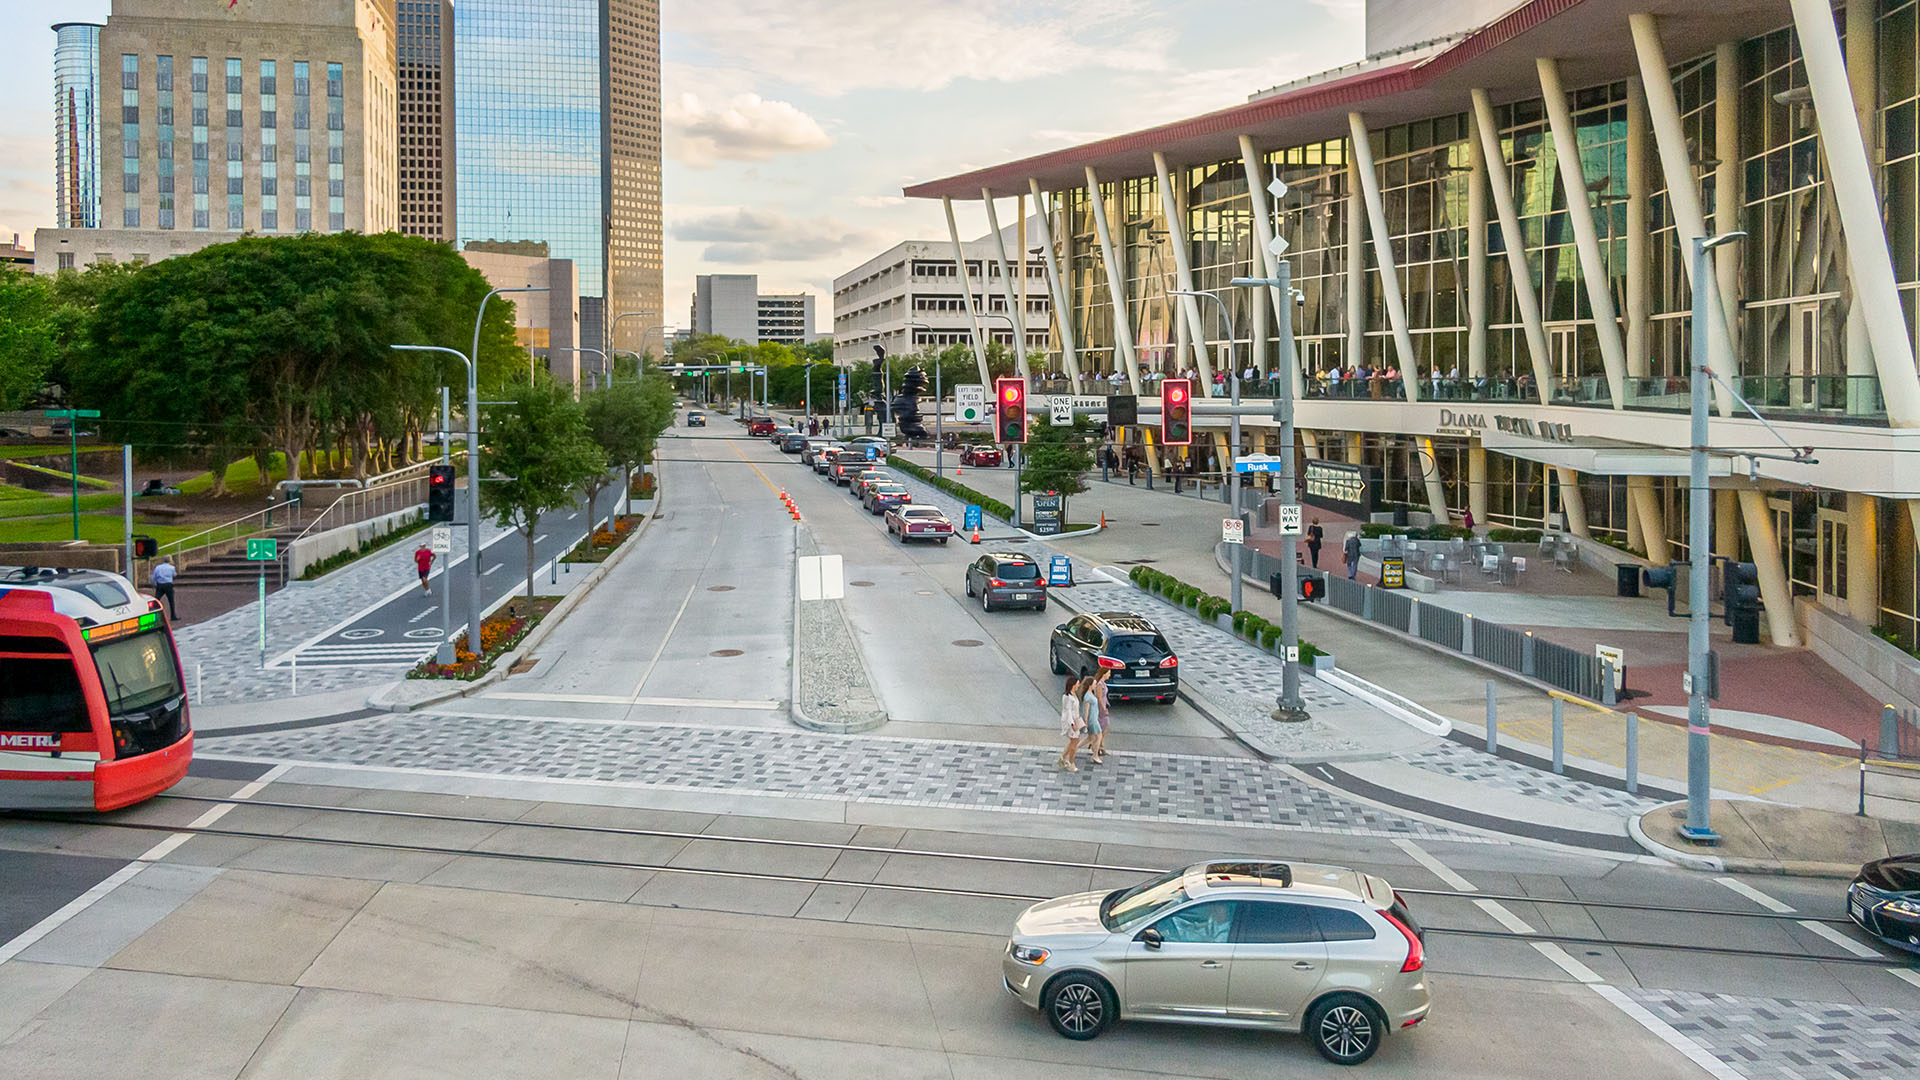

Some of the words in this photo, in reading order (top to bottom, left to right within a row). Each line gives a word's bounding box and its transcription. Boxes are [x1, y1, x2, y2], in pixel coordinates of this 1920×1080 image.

[1053, 397, 1070, 406] ONE
[1053, 406, 1071, 414] WAY
[1439, 408, 1488, 429] DIANA
[1247, 463, 1269, 471] Rusk
[1282, 507, 1299, 515] ONE
[1282, 515, 1299, 523] WAY
[112, 605, 132, 616] 321
